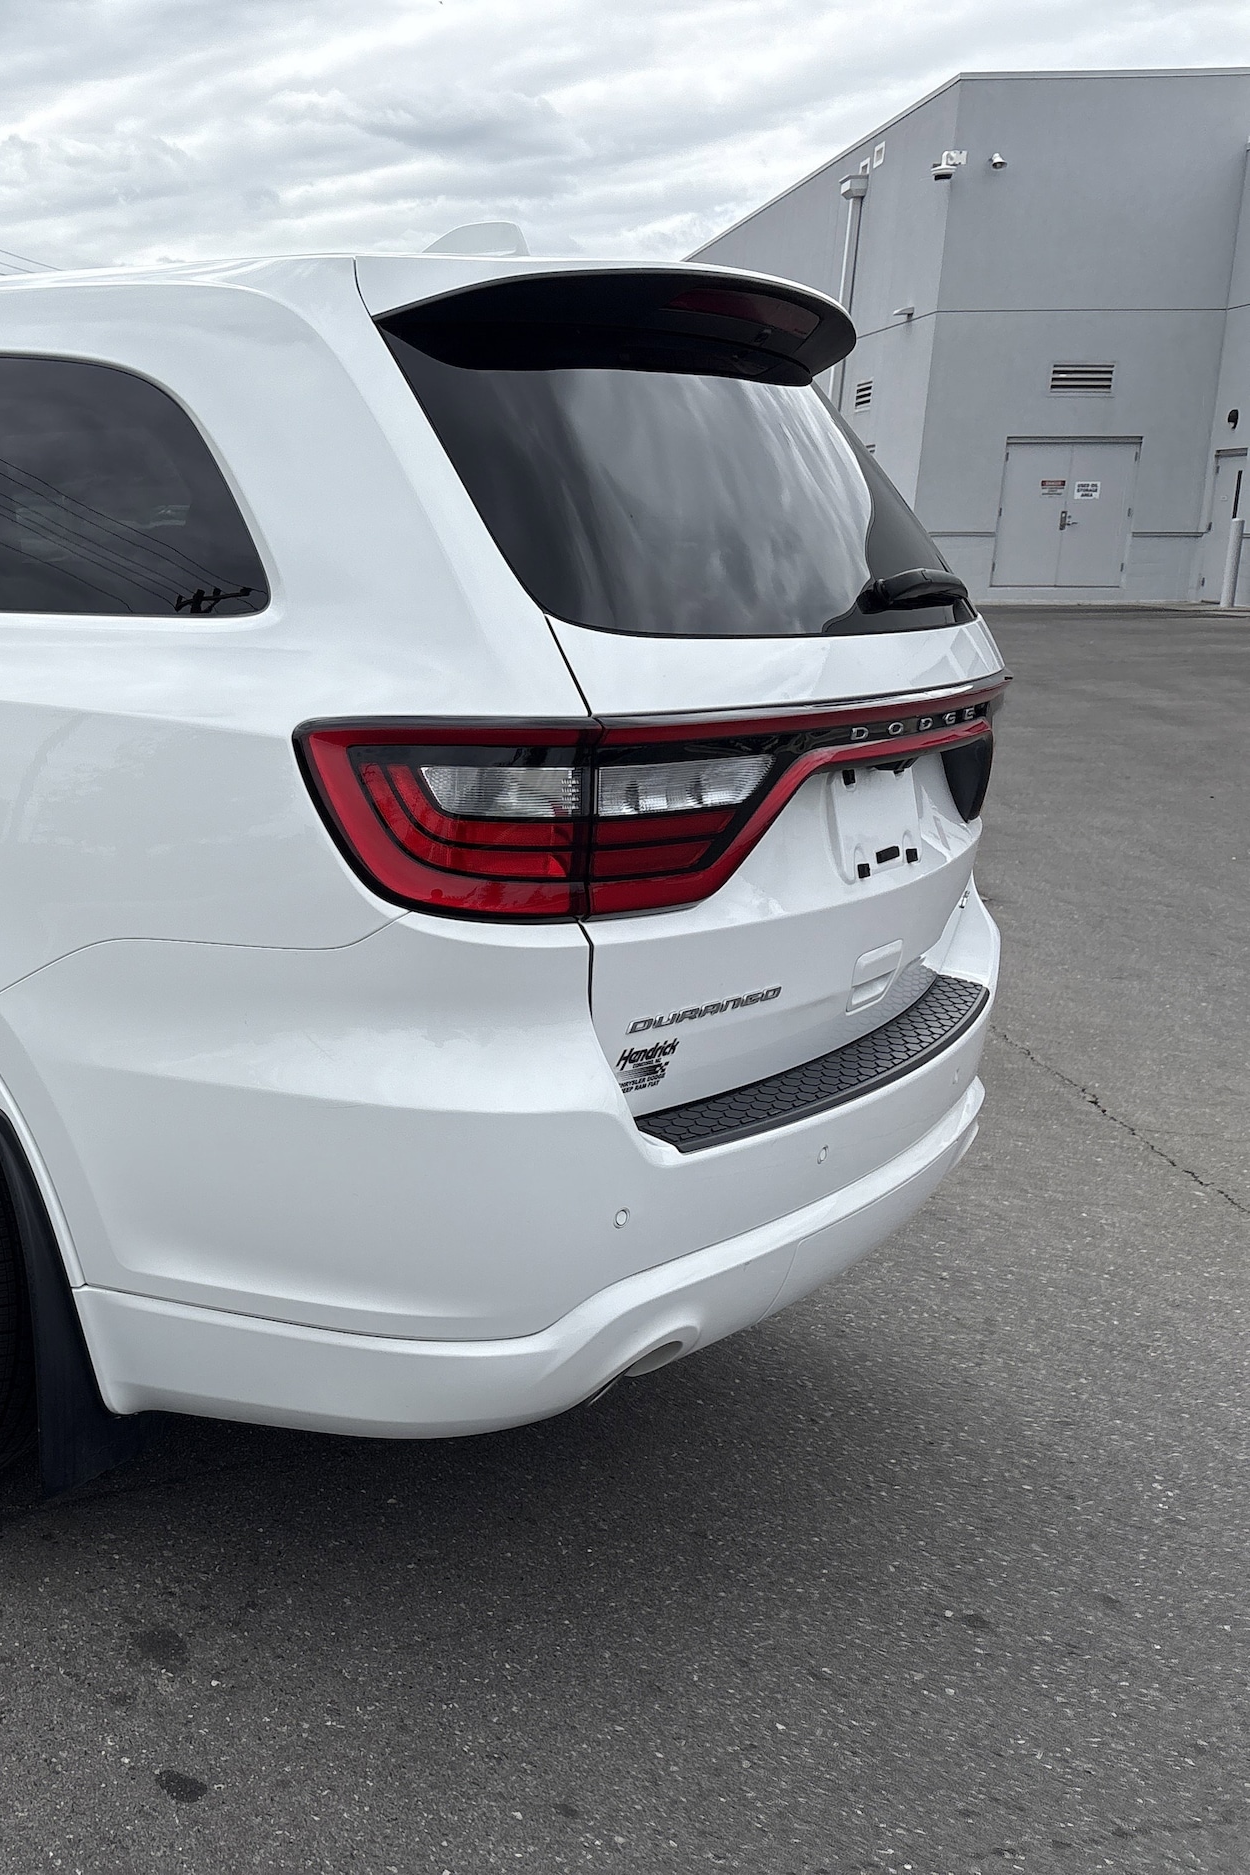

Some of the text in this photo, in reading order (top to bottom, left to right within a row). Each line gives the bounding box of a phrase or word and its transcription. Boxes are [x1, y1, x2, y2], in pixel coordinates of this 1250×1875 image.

[851, 707, 975, 741] DODGE
[626, 985, 782, 1035] DURANGO
[616, 1038, 680, 1070] Hendrick
